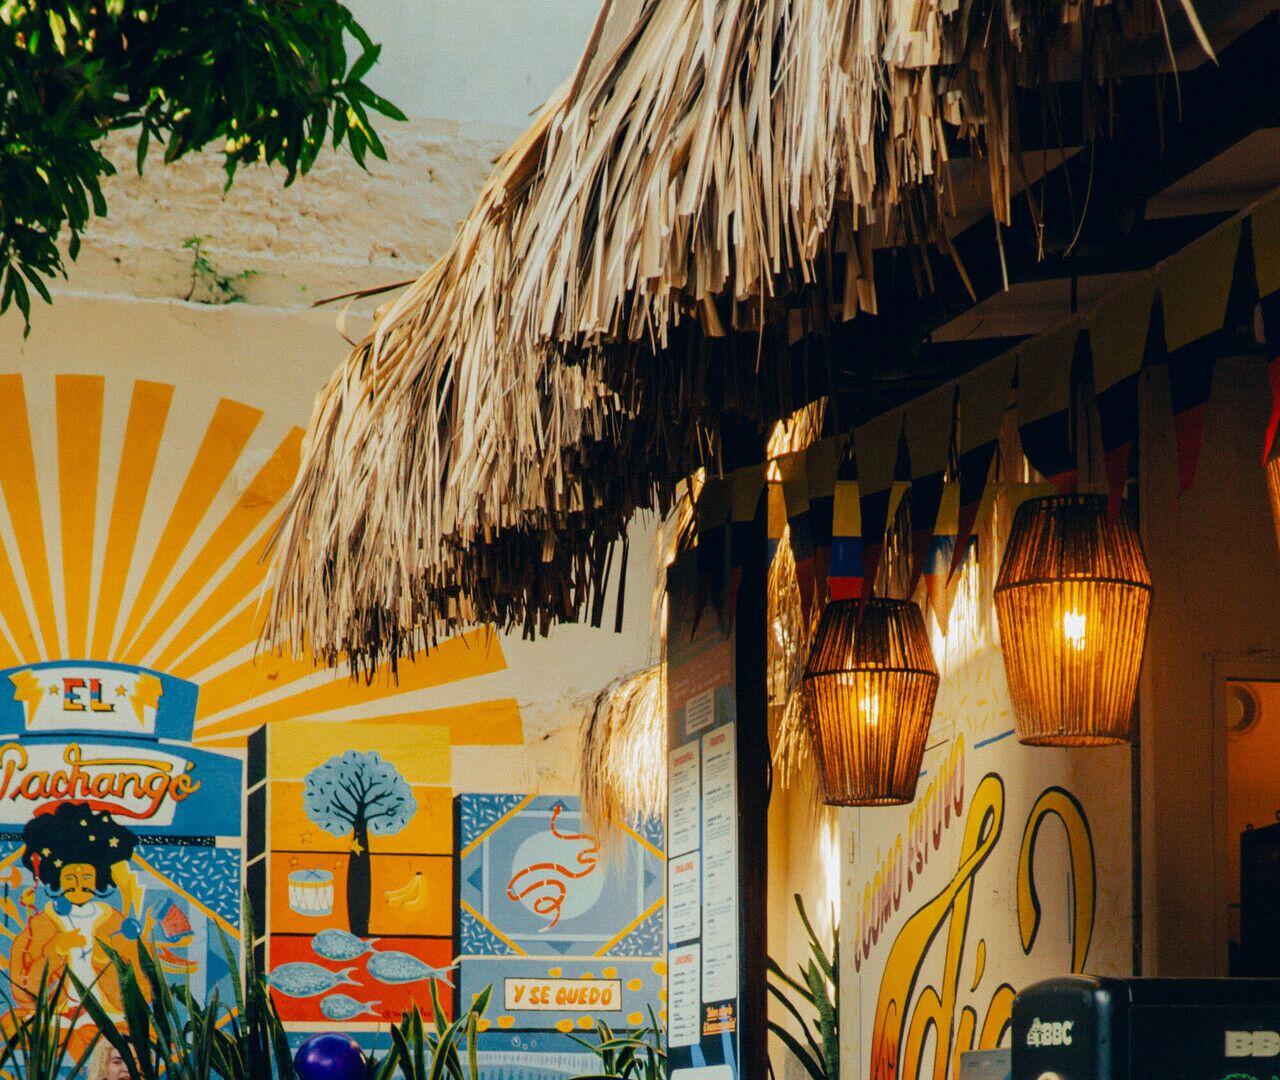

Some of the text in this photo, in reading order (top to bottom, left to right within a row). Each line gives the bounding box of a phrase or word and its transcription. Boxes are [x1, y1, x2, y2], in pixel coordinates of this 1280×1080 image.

[62, 678, 116, 713] EL
[907, 732, 966, 893] ESTUVO
[514, 983, 613, 1006] Y SE QUEDÓ
[1041, 1021, 1073, 1046] BBC
